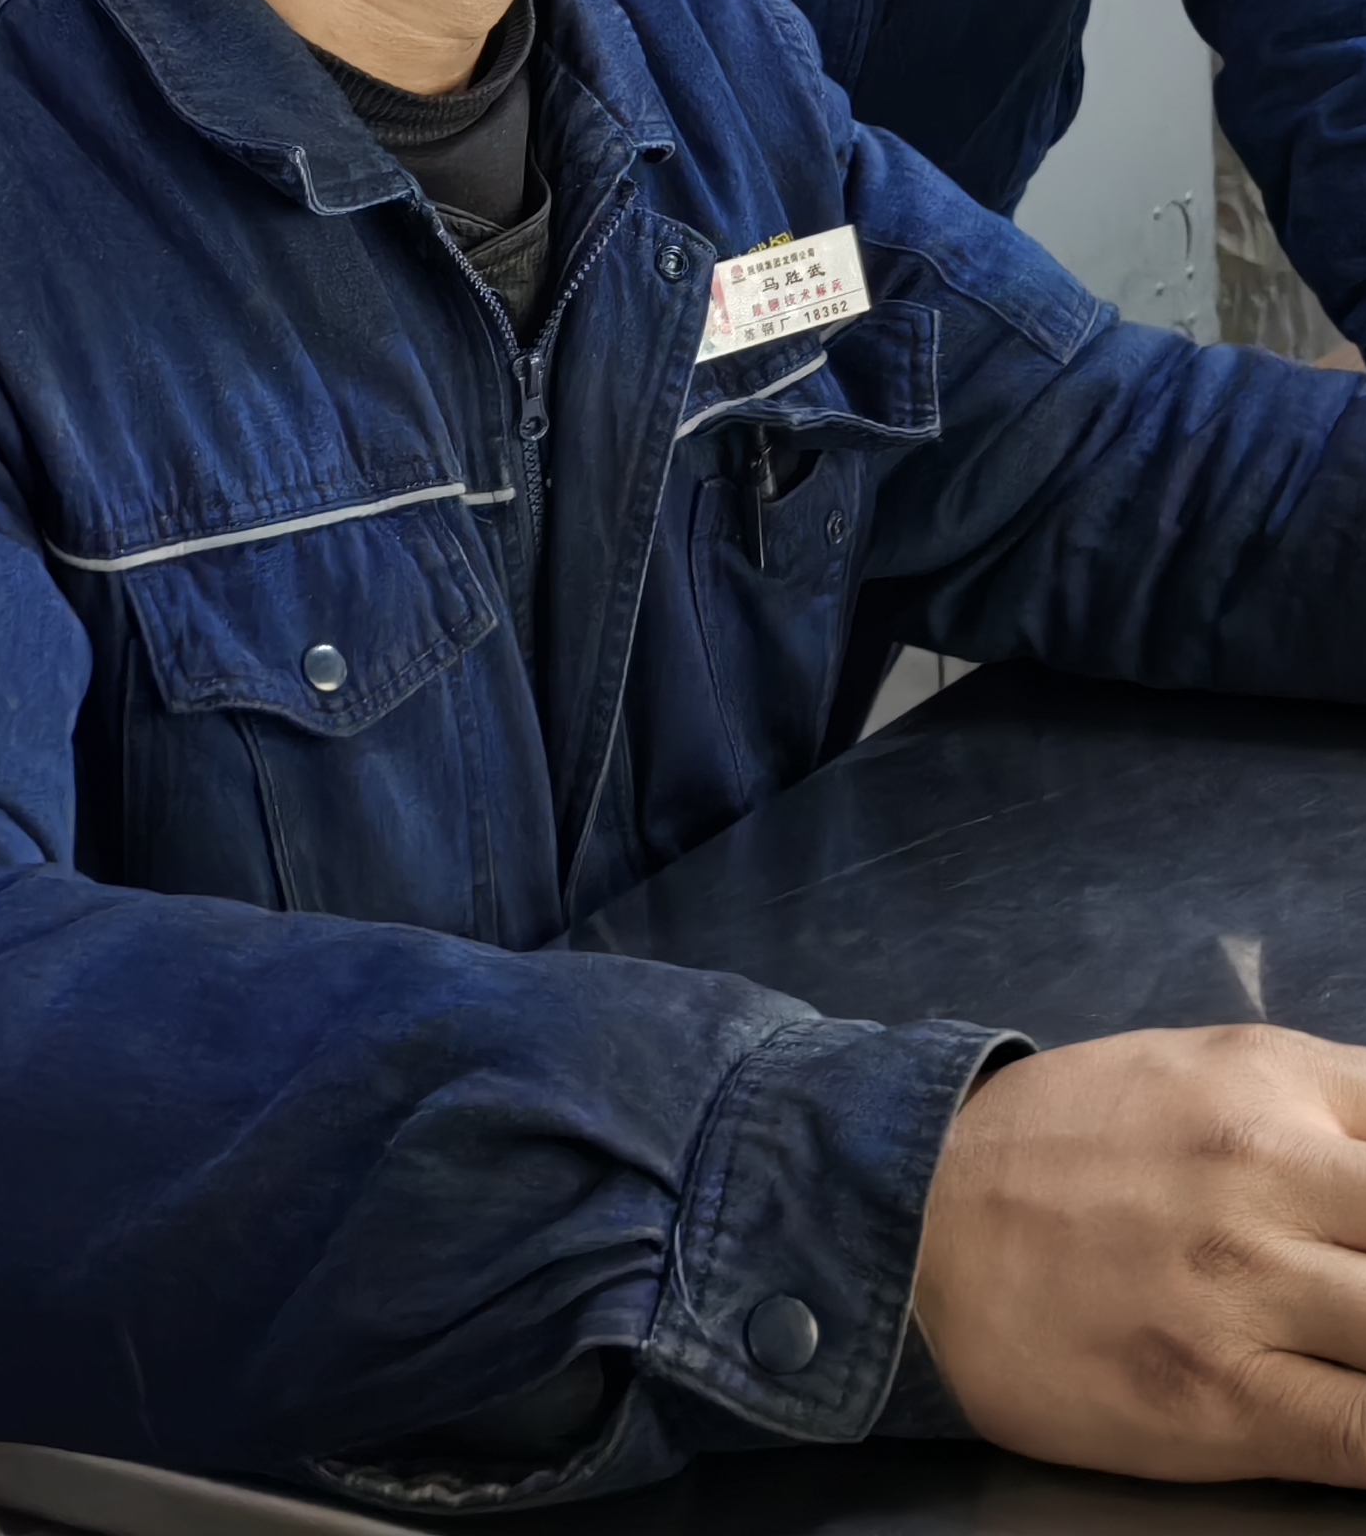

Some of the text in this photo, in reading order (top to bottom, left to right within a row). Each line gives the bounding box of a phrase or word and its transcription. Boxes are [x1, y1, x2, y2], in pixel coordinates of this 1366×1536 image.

[762, 262, 827, 293] 马胜武
[804, 300, 849, 324] 18362
